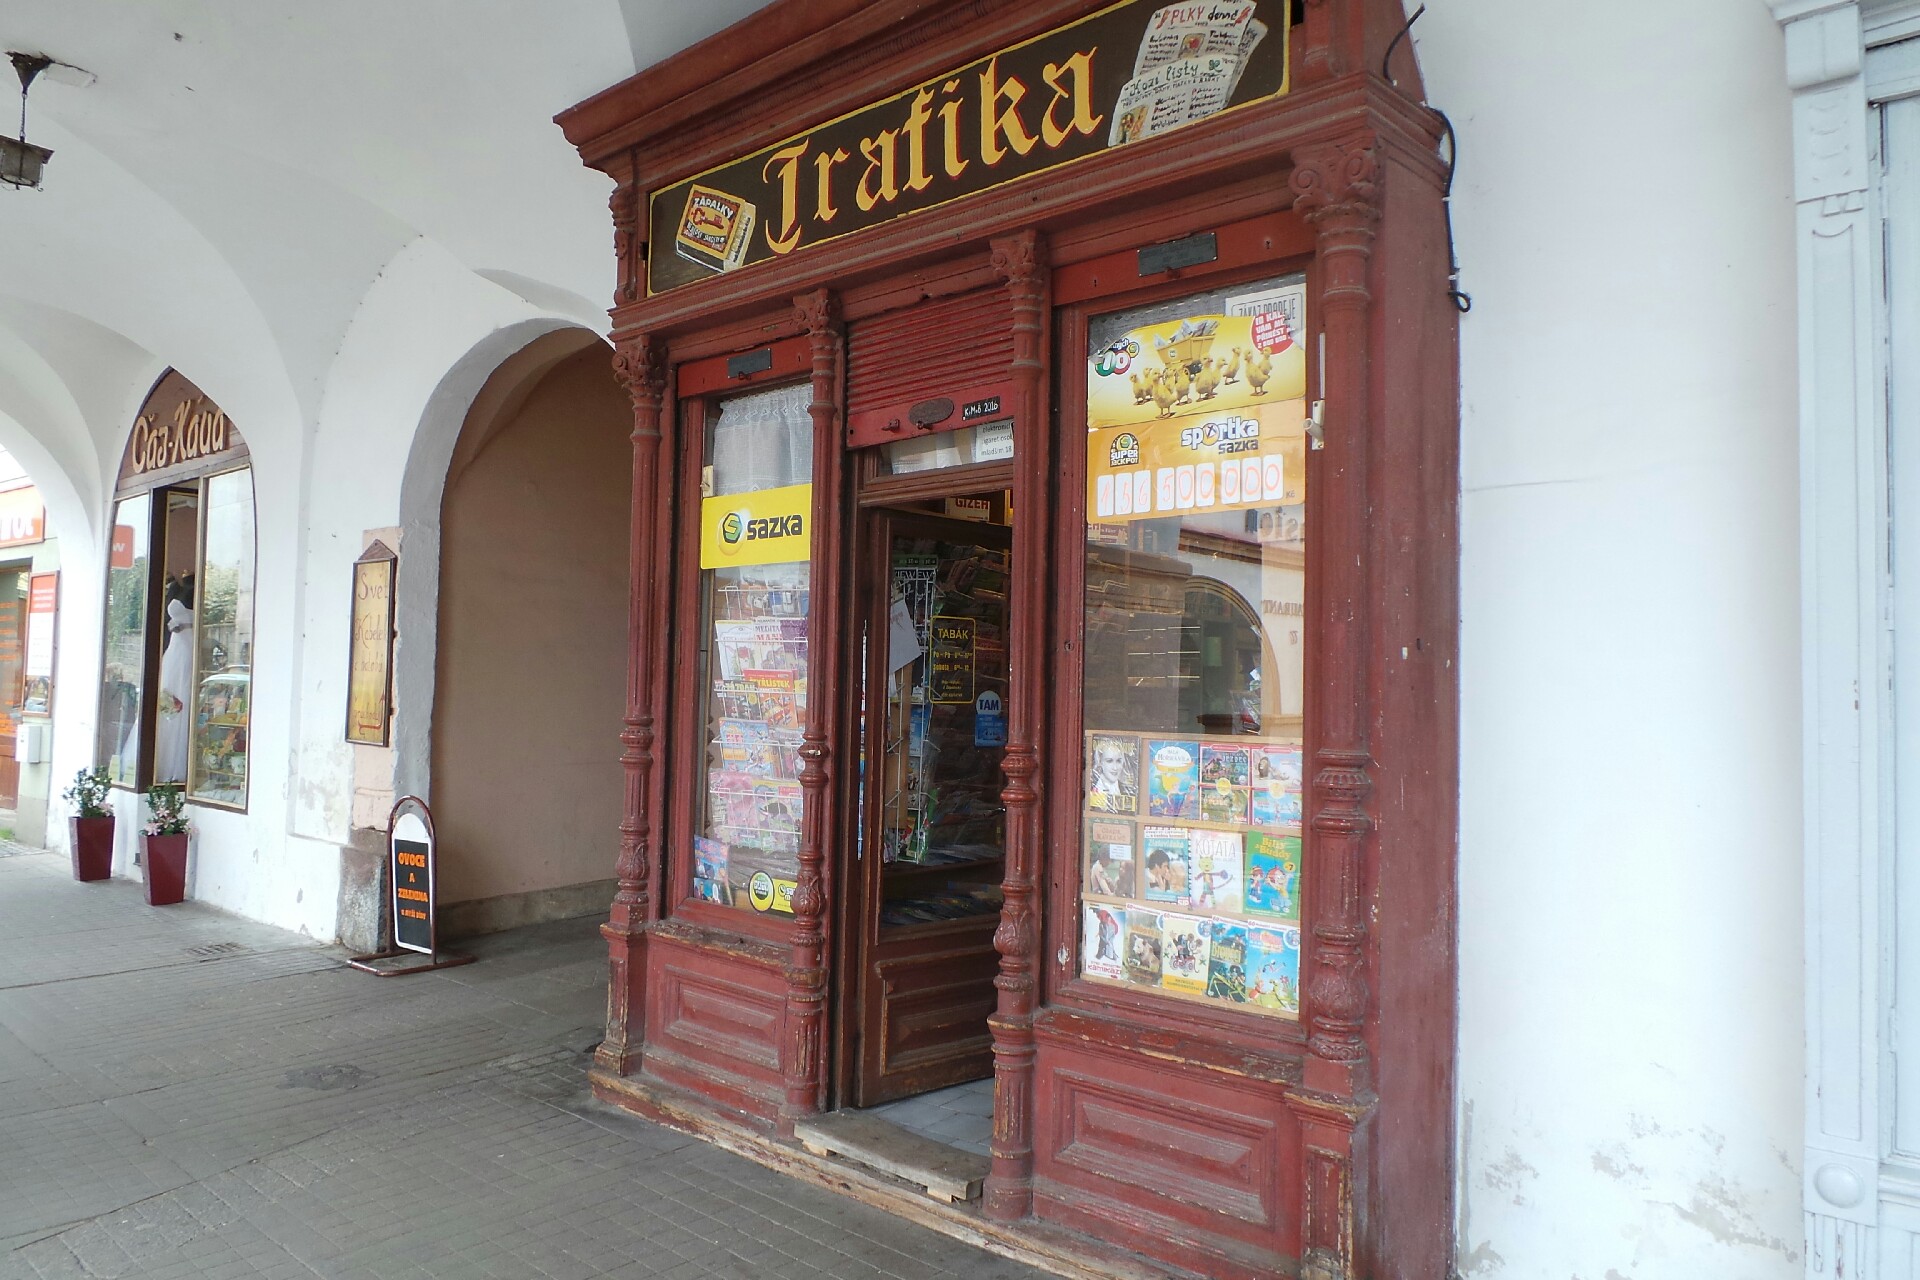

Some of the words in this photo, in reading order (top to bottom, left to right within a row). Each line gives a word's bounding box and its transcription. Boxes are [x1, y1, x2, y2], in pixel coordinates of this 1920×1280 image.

[1170, 5, 1205, 25] PLKY
[1165, 60, 1199, 82] listy
[762, 46, 1104, 254] Trafika
[1181, 416, 1260, 450] sportka
[1110, 449, 1138, 460] SUPER
[938, 627, 969, 640] TABÁK
[398, 852, 426, 868] OVOCE
[409, 872, 415, 883] A
